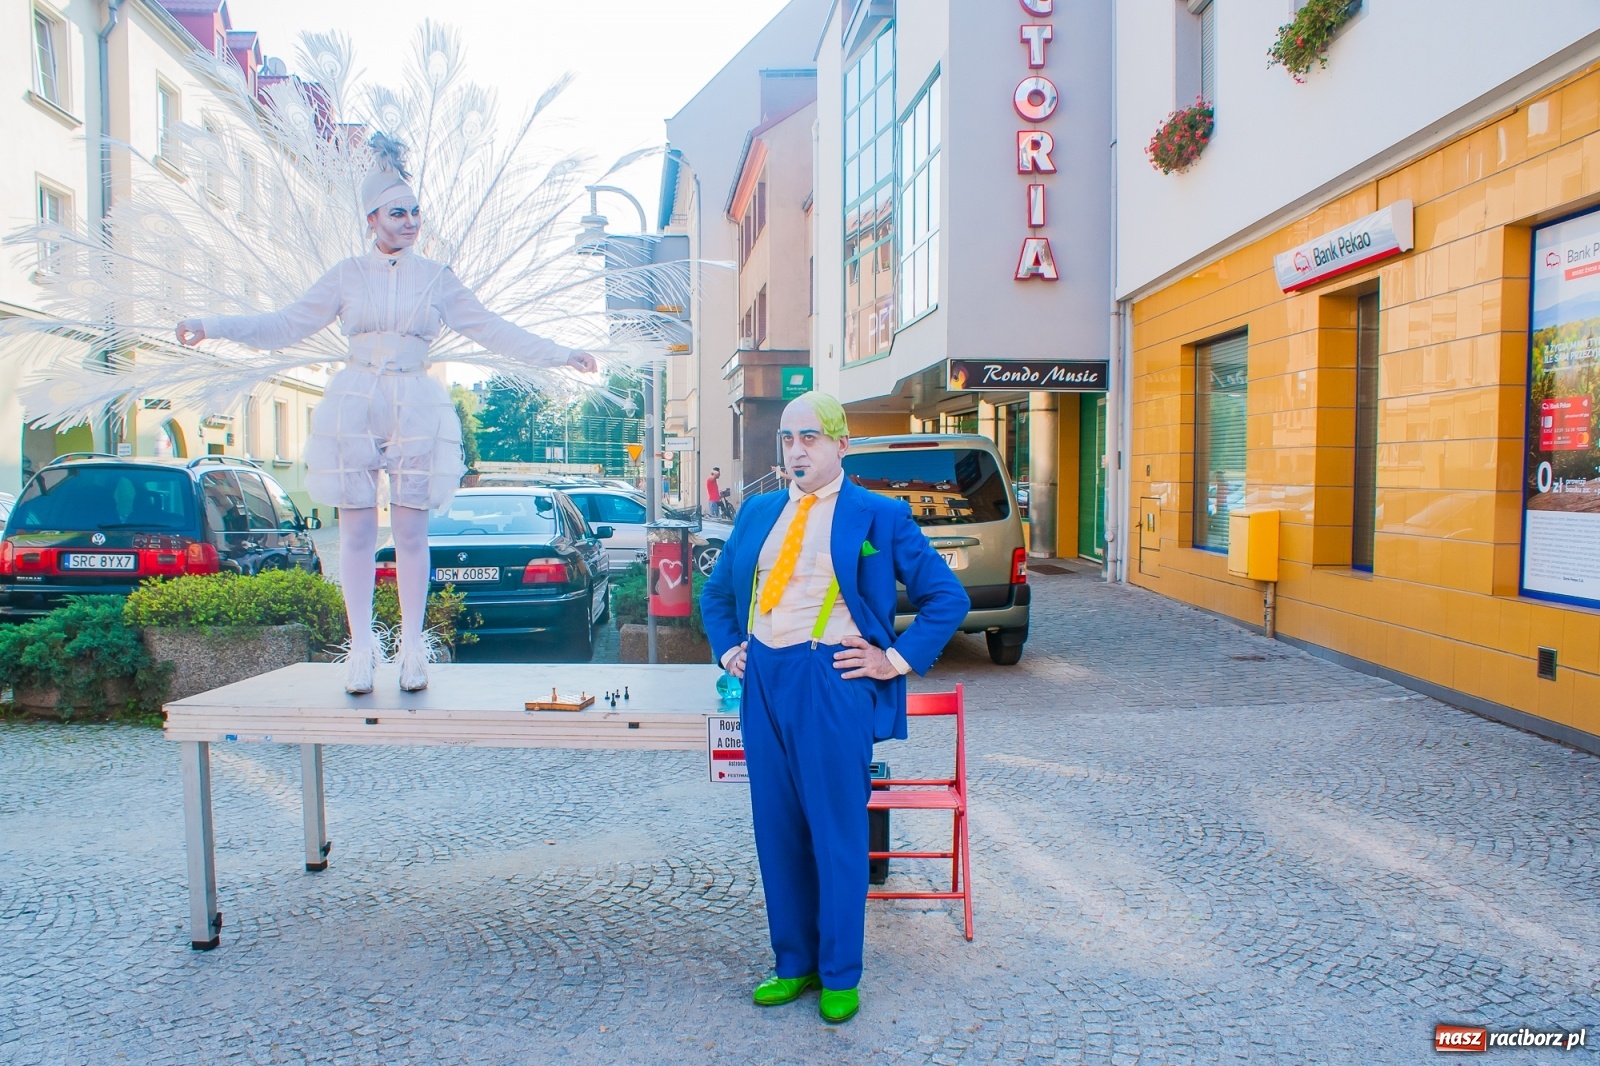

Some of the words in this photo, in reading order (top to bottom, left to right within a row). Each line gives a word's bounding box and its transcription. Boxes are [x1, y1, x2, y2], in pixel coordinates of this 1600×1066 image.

[1313, 240, 1338, 267] Bank
[1338, 231, 1371, 257] Pekao
[1567, 245, 1590, 263] Bank
[982, 364, 1040, 384] Rondo
[1040, 365, 1098, 385] Music
[1537, 461, 1552, 493] 0
[1552, 477, 1563, 493] zł
[72, 556, 95, 567] SRC
[100, 556, 132, 567] 8YX7
[437, 569, 459, 580] DSW
[462, 568, 498, 580] 60852
[717, 737, 723, 748] A
[725, 737, 744, 748] Che
